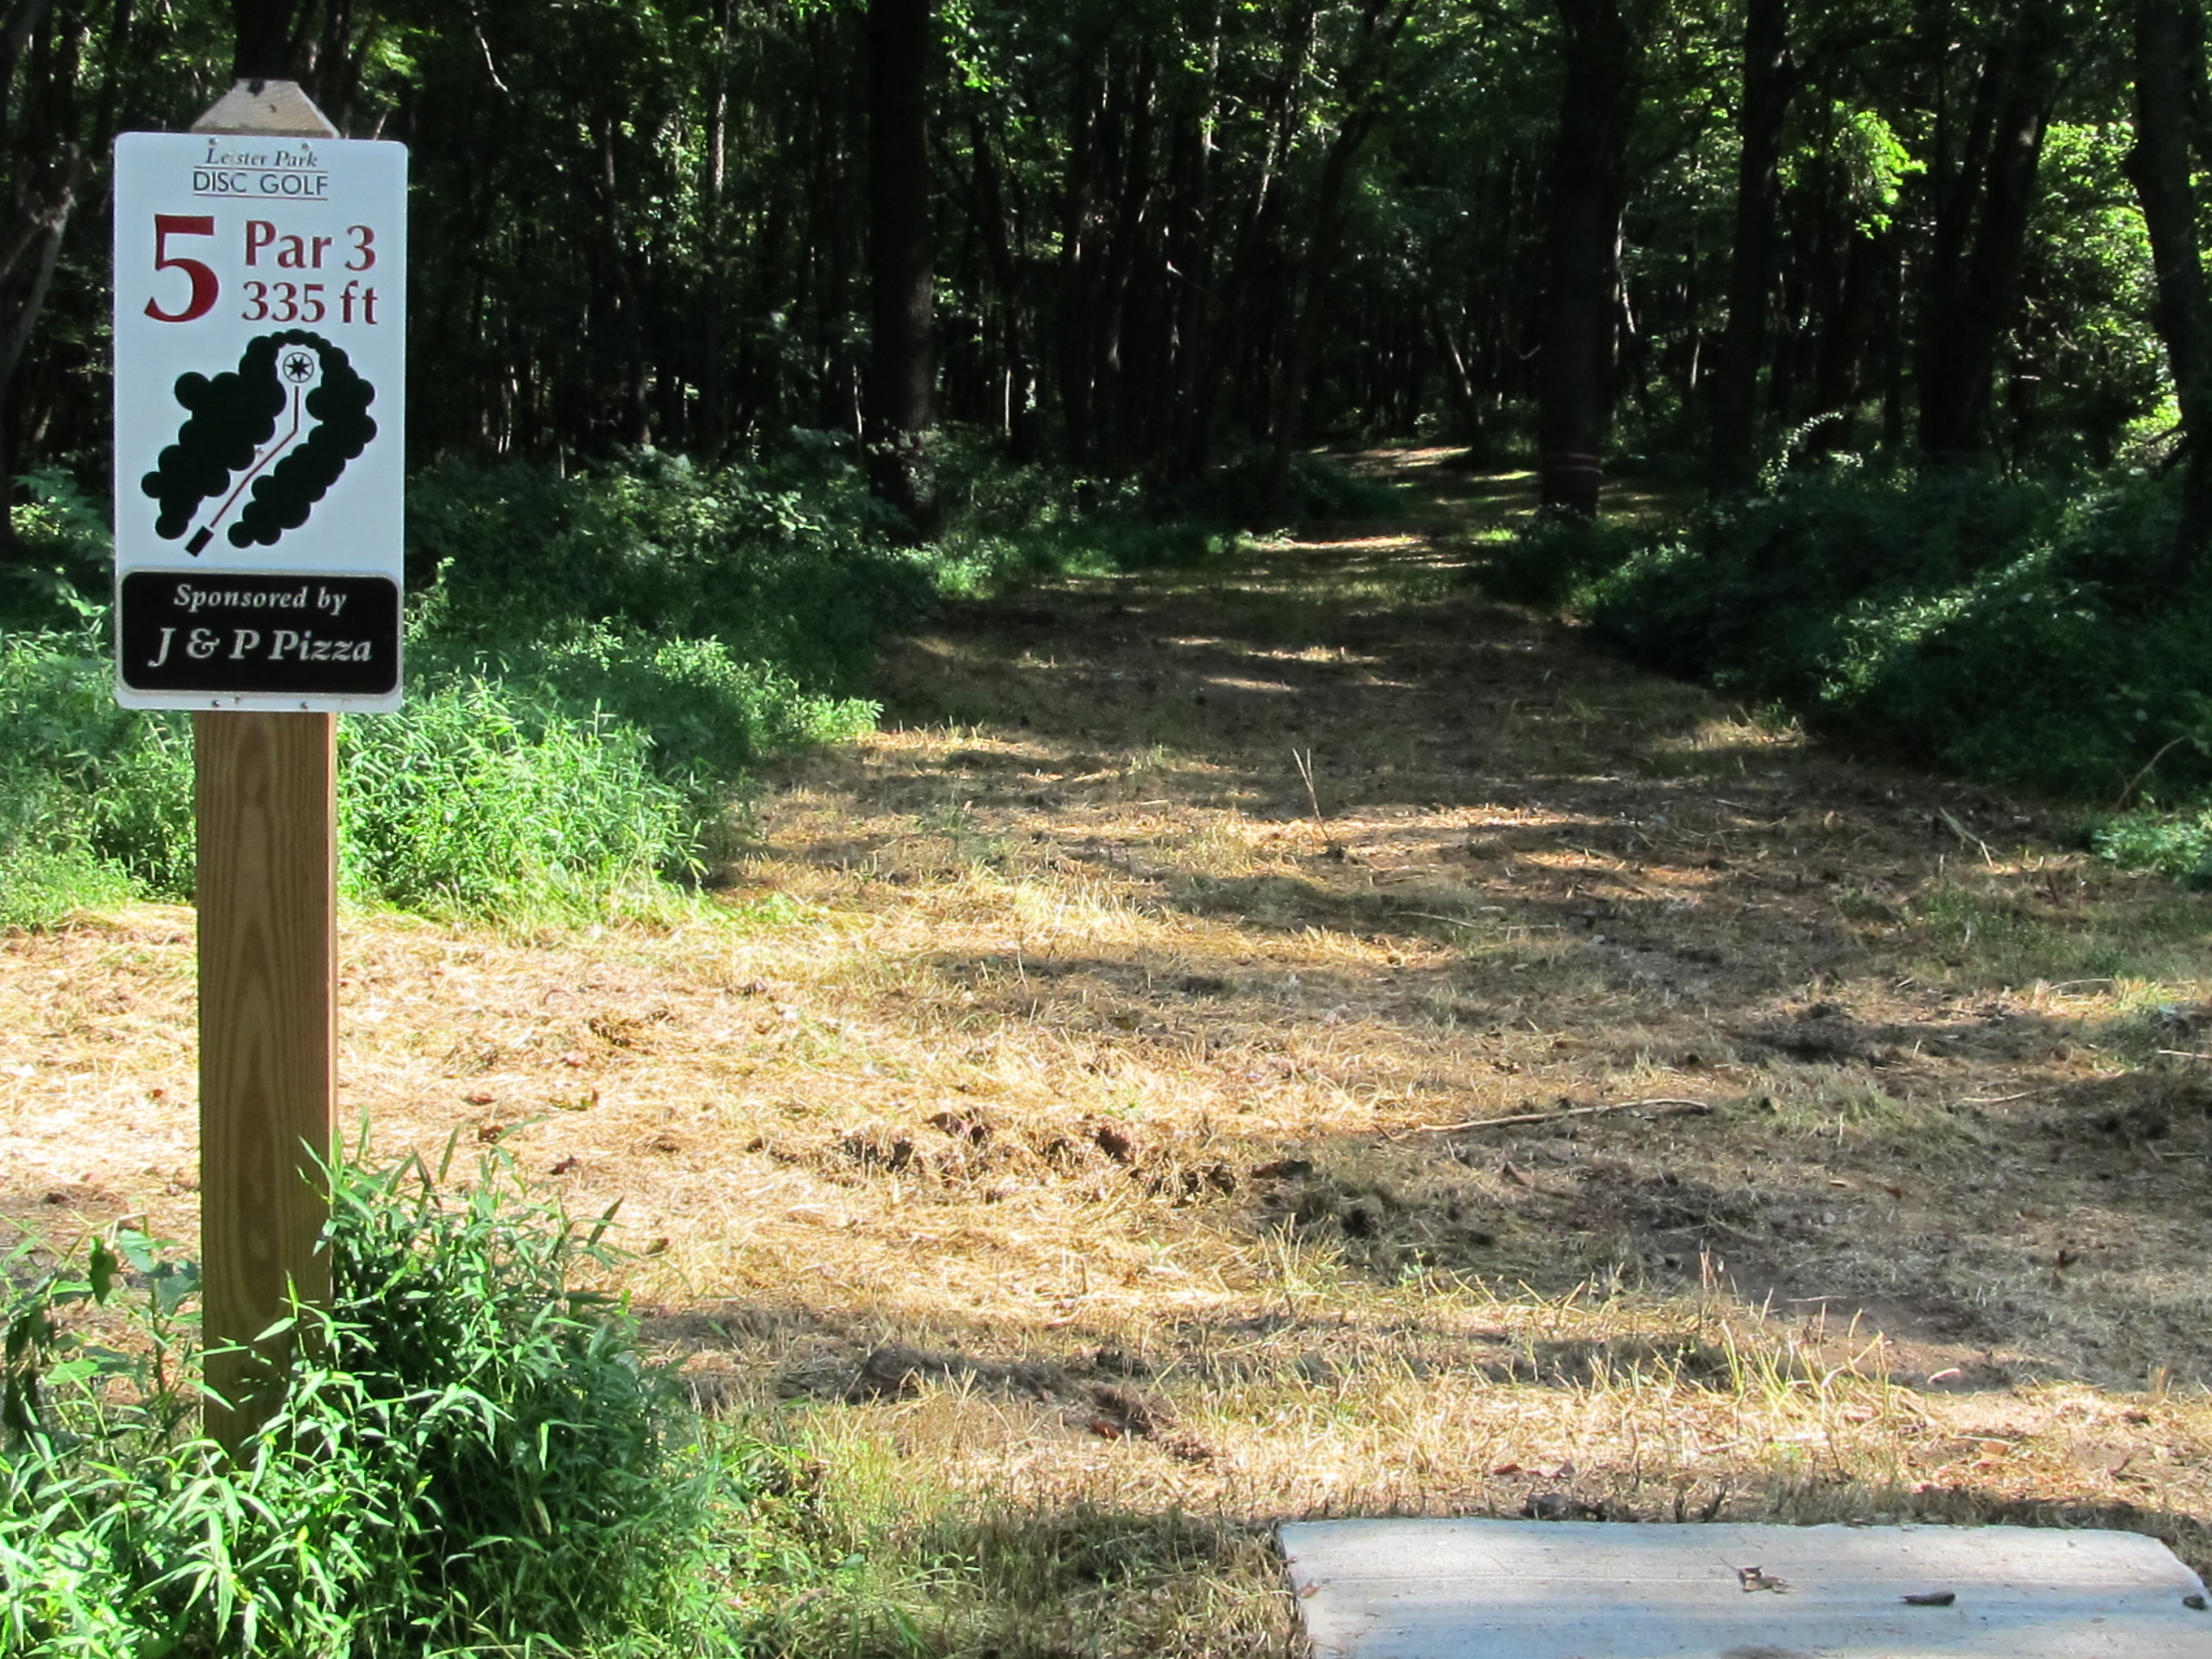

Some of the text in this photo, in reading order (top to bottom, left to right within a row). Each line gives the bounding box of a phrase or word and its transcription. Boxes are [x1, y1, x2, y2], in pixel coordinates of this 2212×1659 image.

[275, 150, 317, 166] Park
[193, 171, 328, 195] DISC GOLF
[245, 220, 376, 271] Par 3
[144, 213, 219, 322] 5
[241, 280, 378, 325] 335 ft
[174, 584, 347, 615] Sponsored by
[148, 627, 372, 667] J & P Pizza
